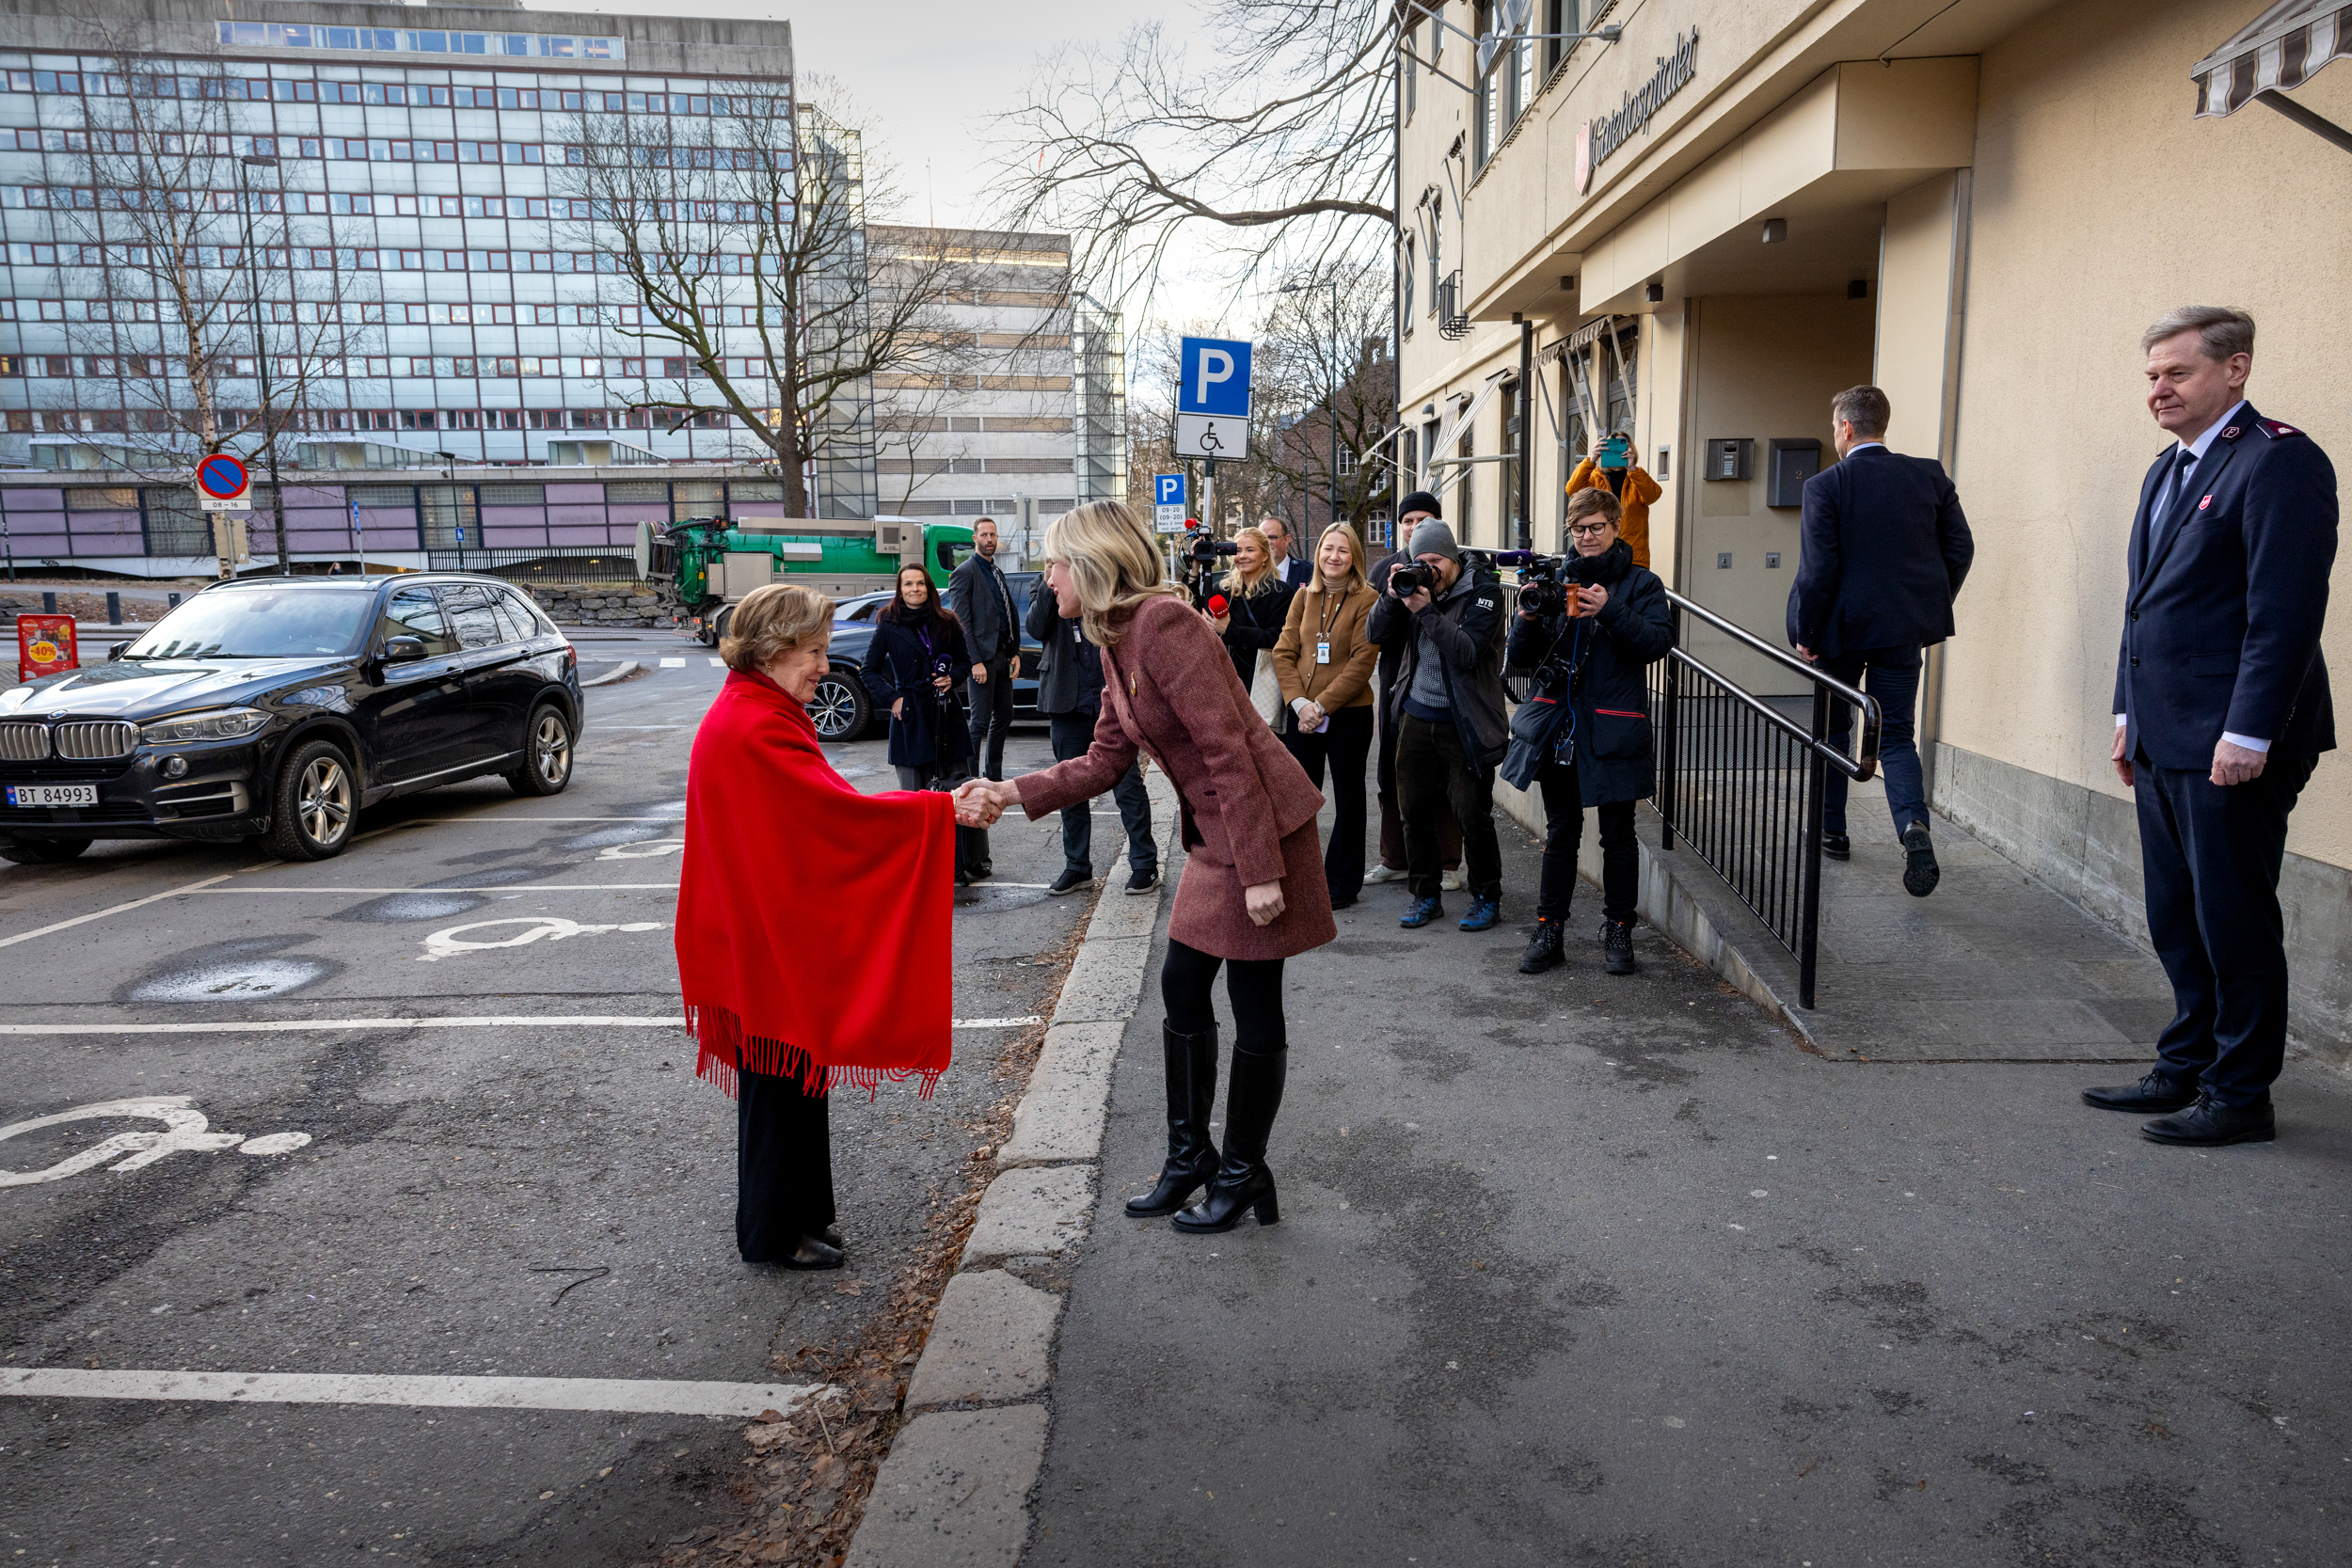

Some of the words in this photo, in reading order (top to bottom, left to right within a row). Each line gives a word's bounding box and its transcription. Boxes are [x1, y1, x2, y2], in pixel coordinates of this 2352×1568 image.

[1591, 24, 1699, 166] Gatehospitalet
[1197, 348, 1234, 404] P
[2226, 428, 2236, 436] F
[1795, 470, 1803, 480] 2
[1162, 479, 1178, 501] P
[1517, 555, 1523, 564] 2
[1477, 597, 1494, 608] NTB
[30, 646, 56, 656] -40%
[937, 662, 946, 673] 2
[19, 788, 36, 803] BT
[43, 787, 92, 803] 84993
